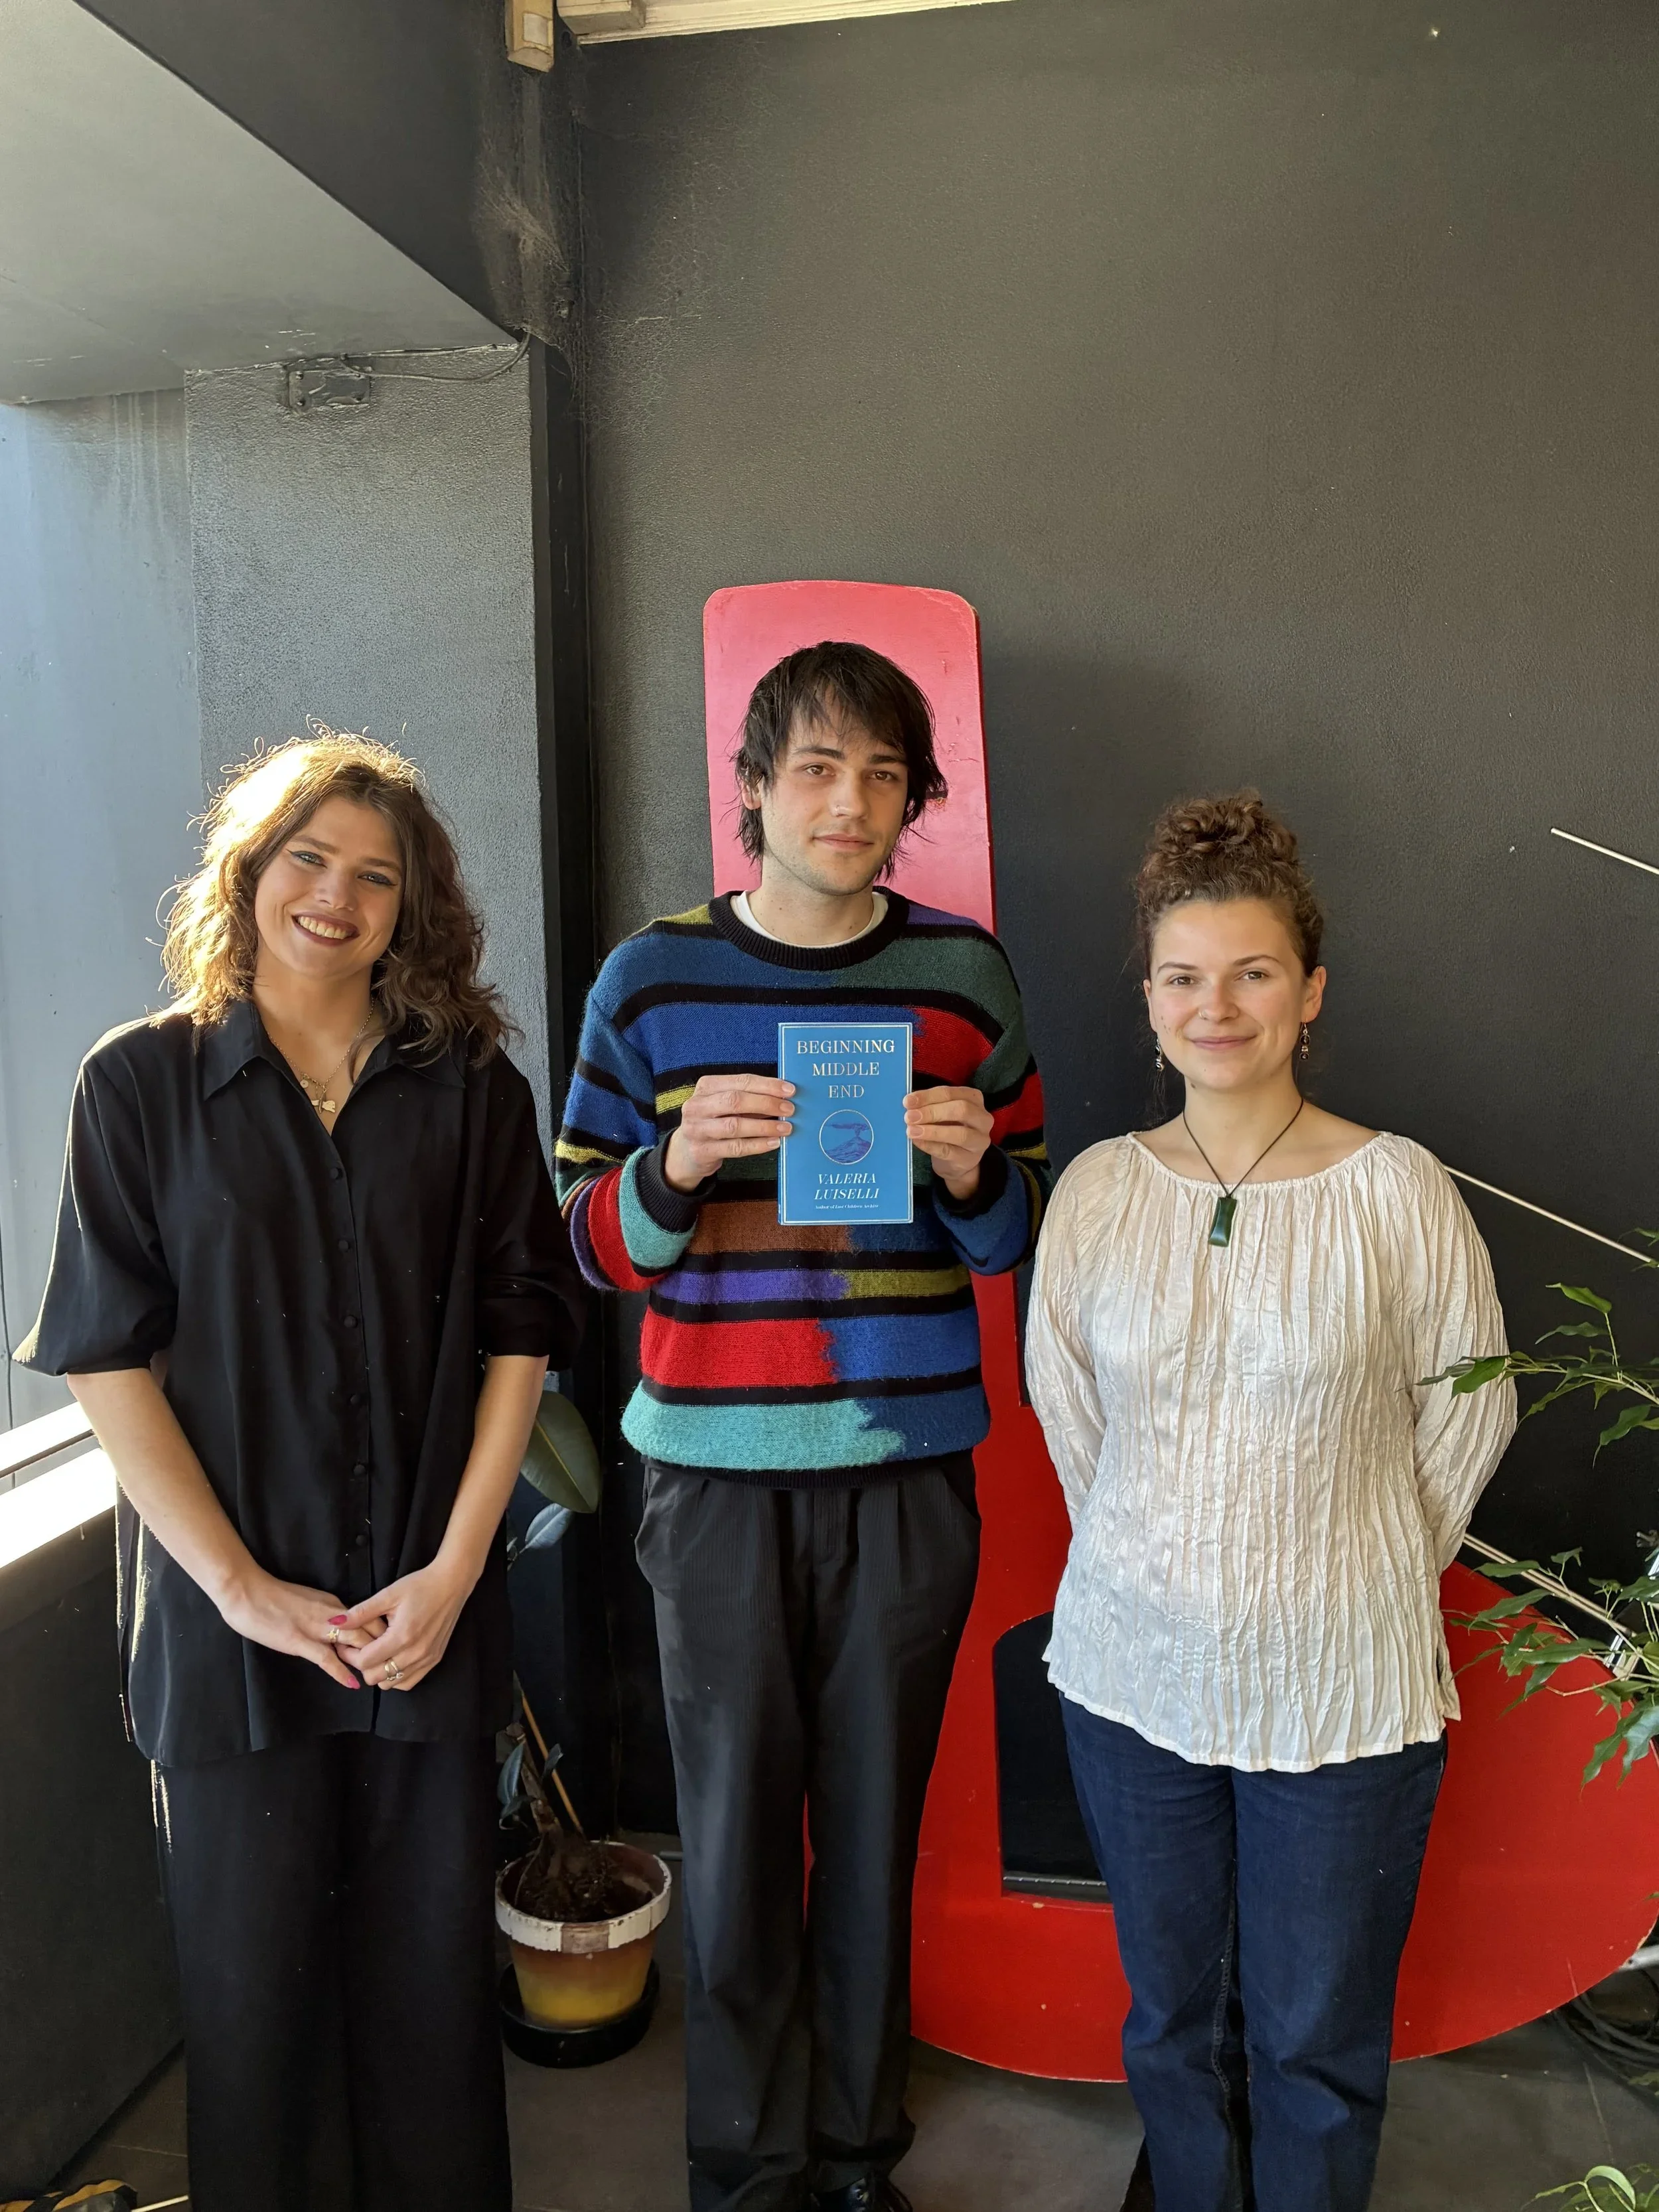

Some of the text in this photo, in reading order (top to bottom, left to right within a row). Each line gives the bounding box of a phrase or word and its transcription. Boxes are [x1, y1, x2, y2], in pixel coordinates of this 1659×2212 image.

[797, 1039, 895, 1054] BEGINNING
[812, 1062, 879, 1076] MIDDLE
[828, 1084, 865, 1098] END
[818, 1173, 877, 1185] VALERIA
[814, 1188, 880, 1201] LUISELLI
